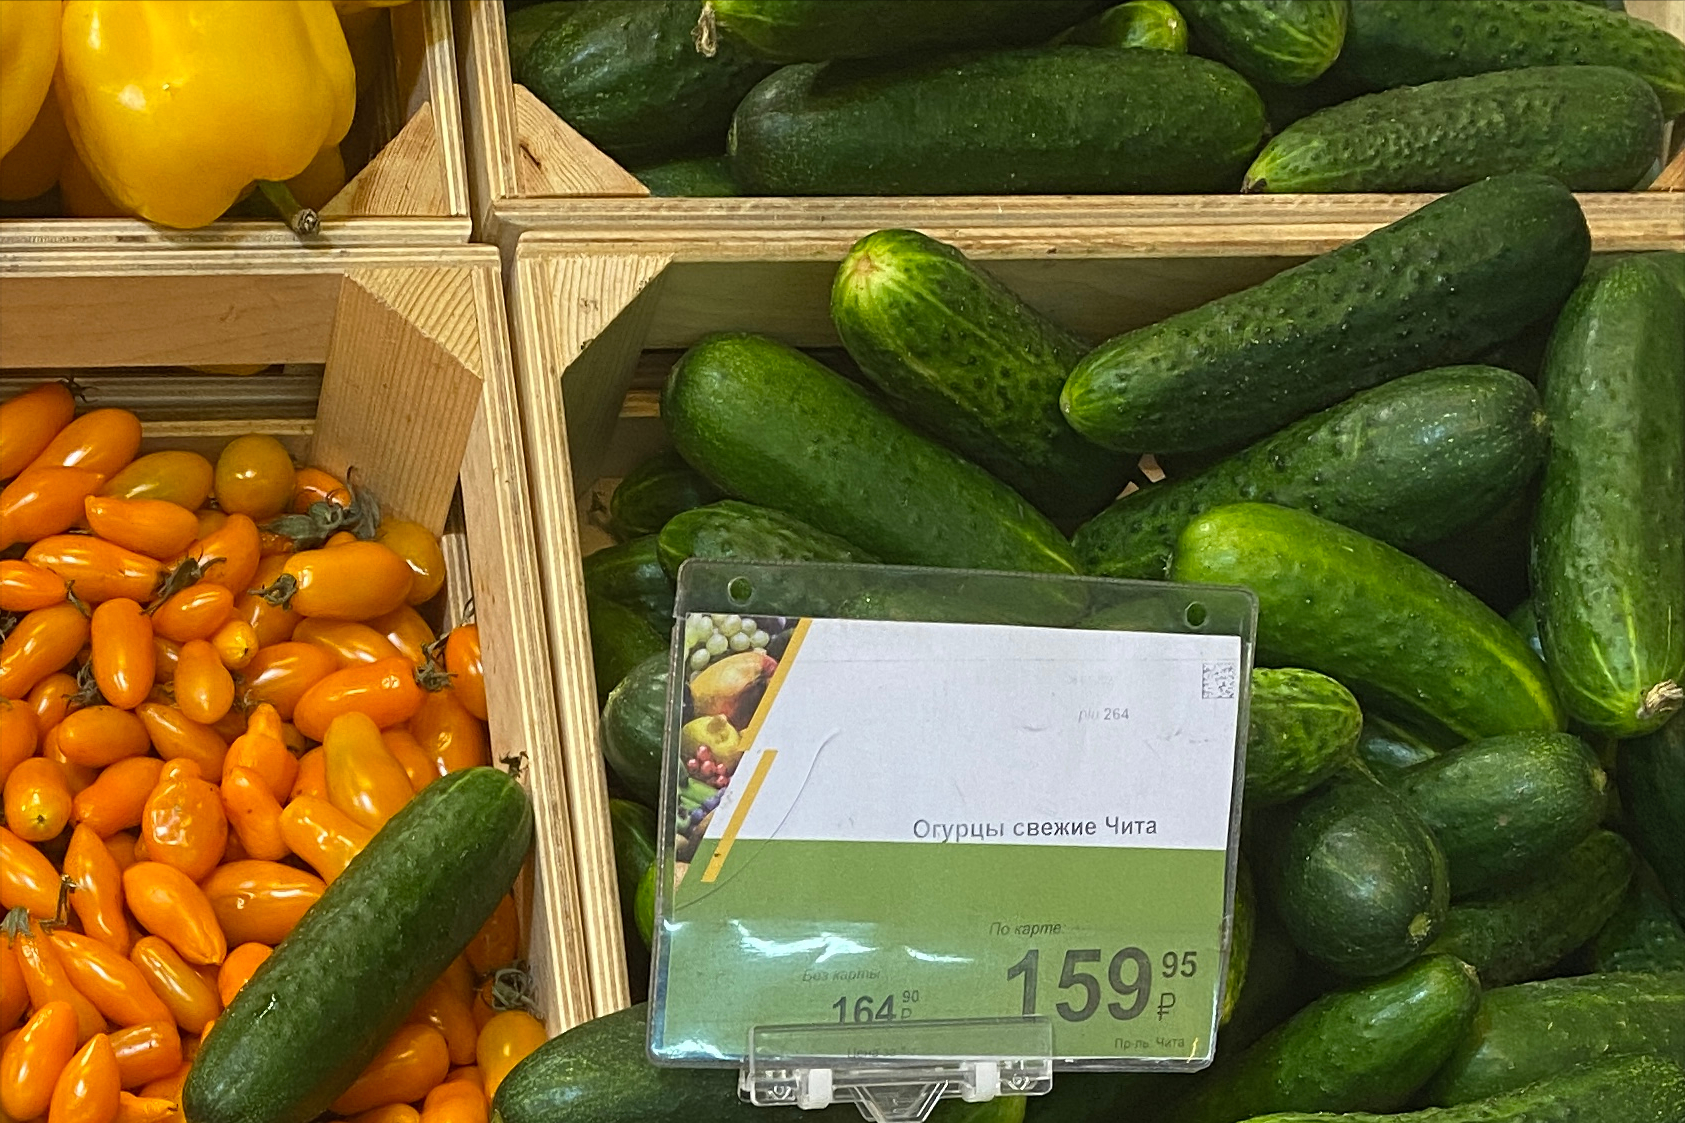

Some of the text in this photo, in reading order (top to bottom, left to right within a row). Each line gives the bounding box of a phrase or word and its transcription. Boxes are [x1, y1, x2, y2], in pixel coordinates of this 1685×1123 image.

[1103, 707, 1129, 721] 264
[913, 816, 1157, 844] Огурцы свежие Чита
[989, 921, 1011, 935] По
[802, 969, 881, 982] Без карты
[1007, 947, 1198, 1022] 159 95
[832, 990, 920, 1024] 164 90
[1155, 1037, 1185, 1048] Чита
